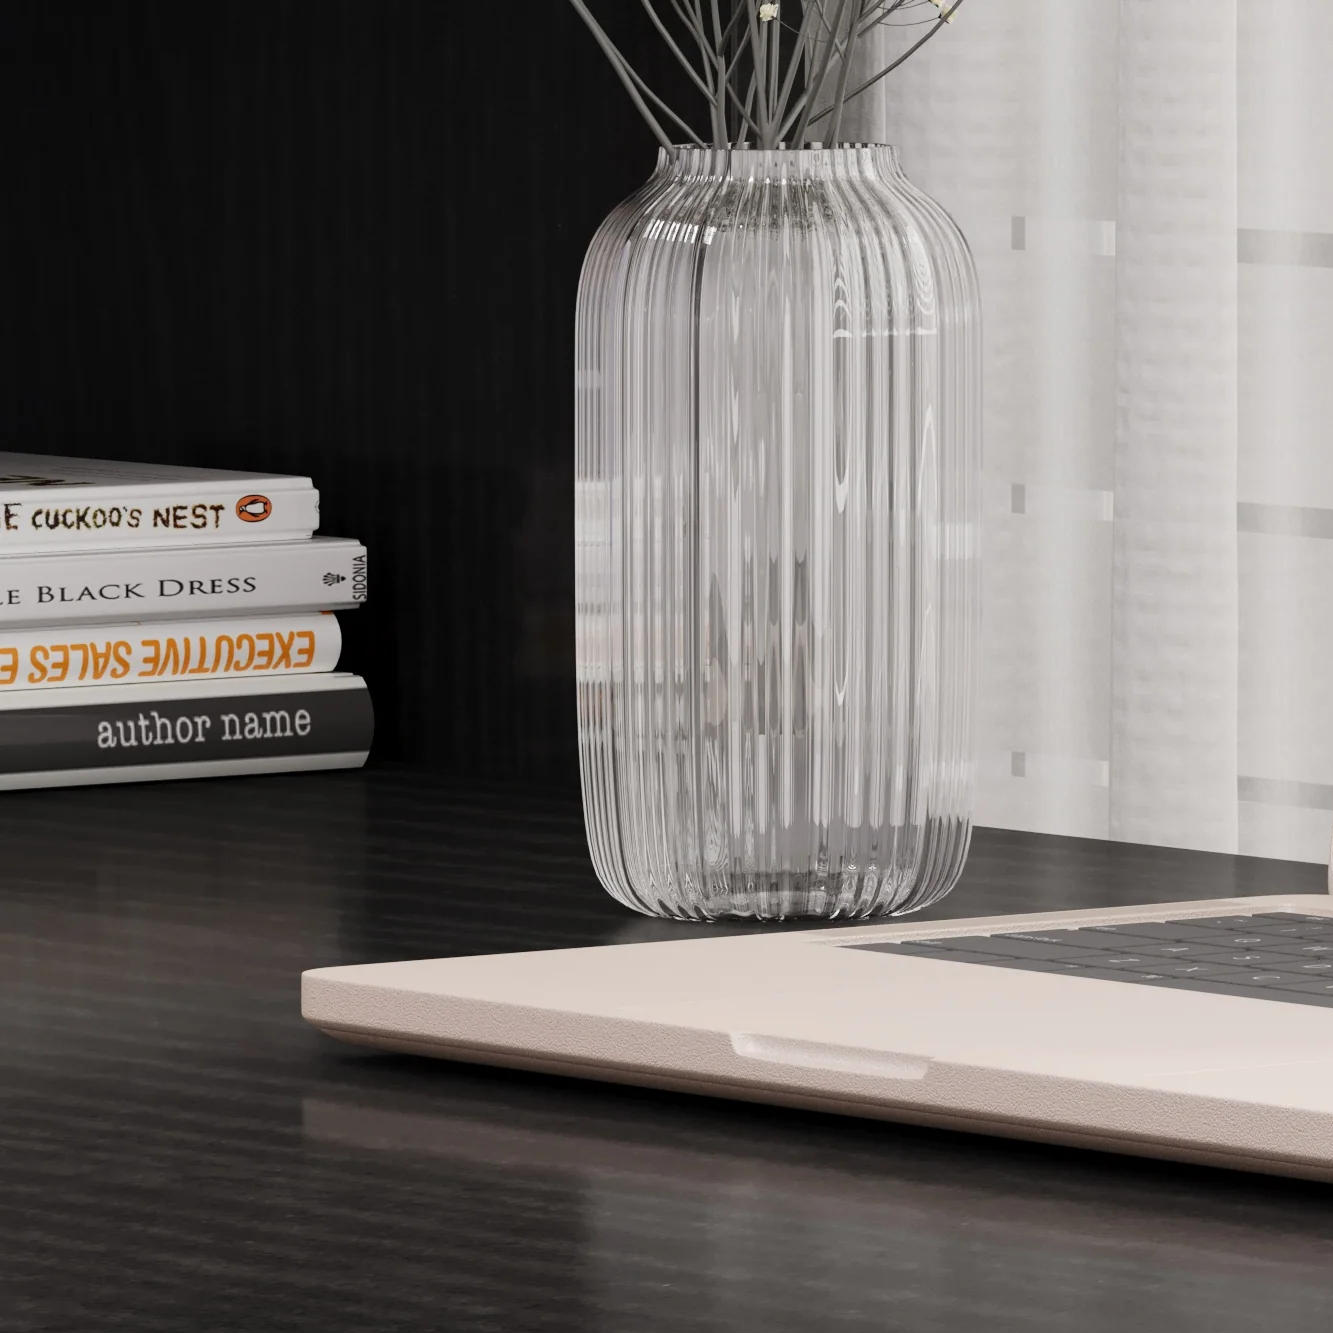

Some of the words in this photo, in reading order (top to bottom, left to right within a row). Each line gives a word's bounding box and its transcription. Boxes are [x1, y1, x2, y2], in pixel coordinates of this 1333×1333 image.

[31, 506, 142, 530] CUCKOO'S
[153, 503, 226, 529] NEST
[37, 582, 146, 604] BLACK
[158, 576, 257, 597] DRESS
[352, 555, 367, 600] SIDONIA
[28, 640, 132, 684] SALES
[138, 630, 315, 677] EXECUTIVE
[97, 711, 211, 748] author
[221, 708, 312, 741] name
